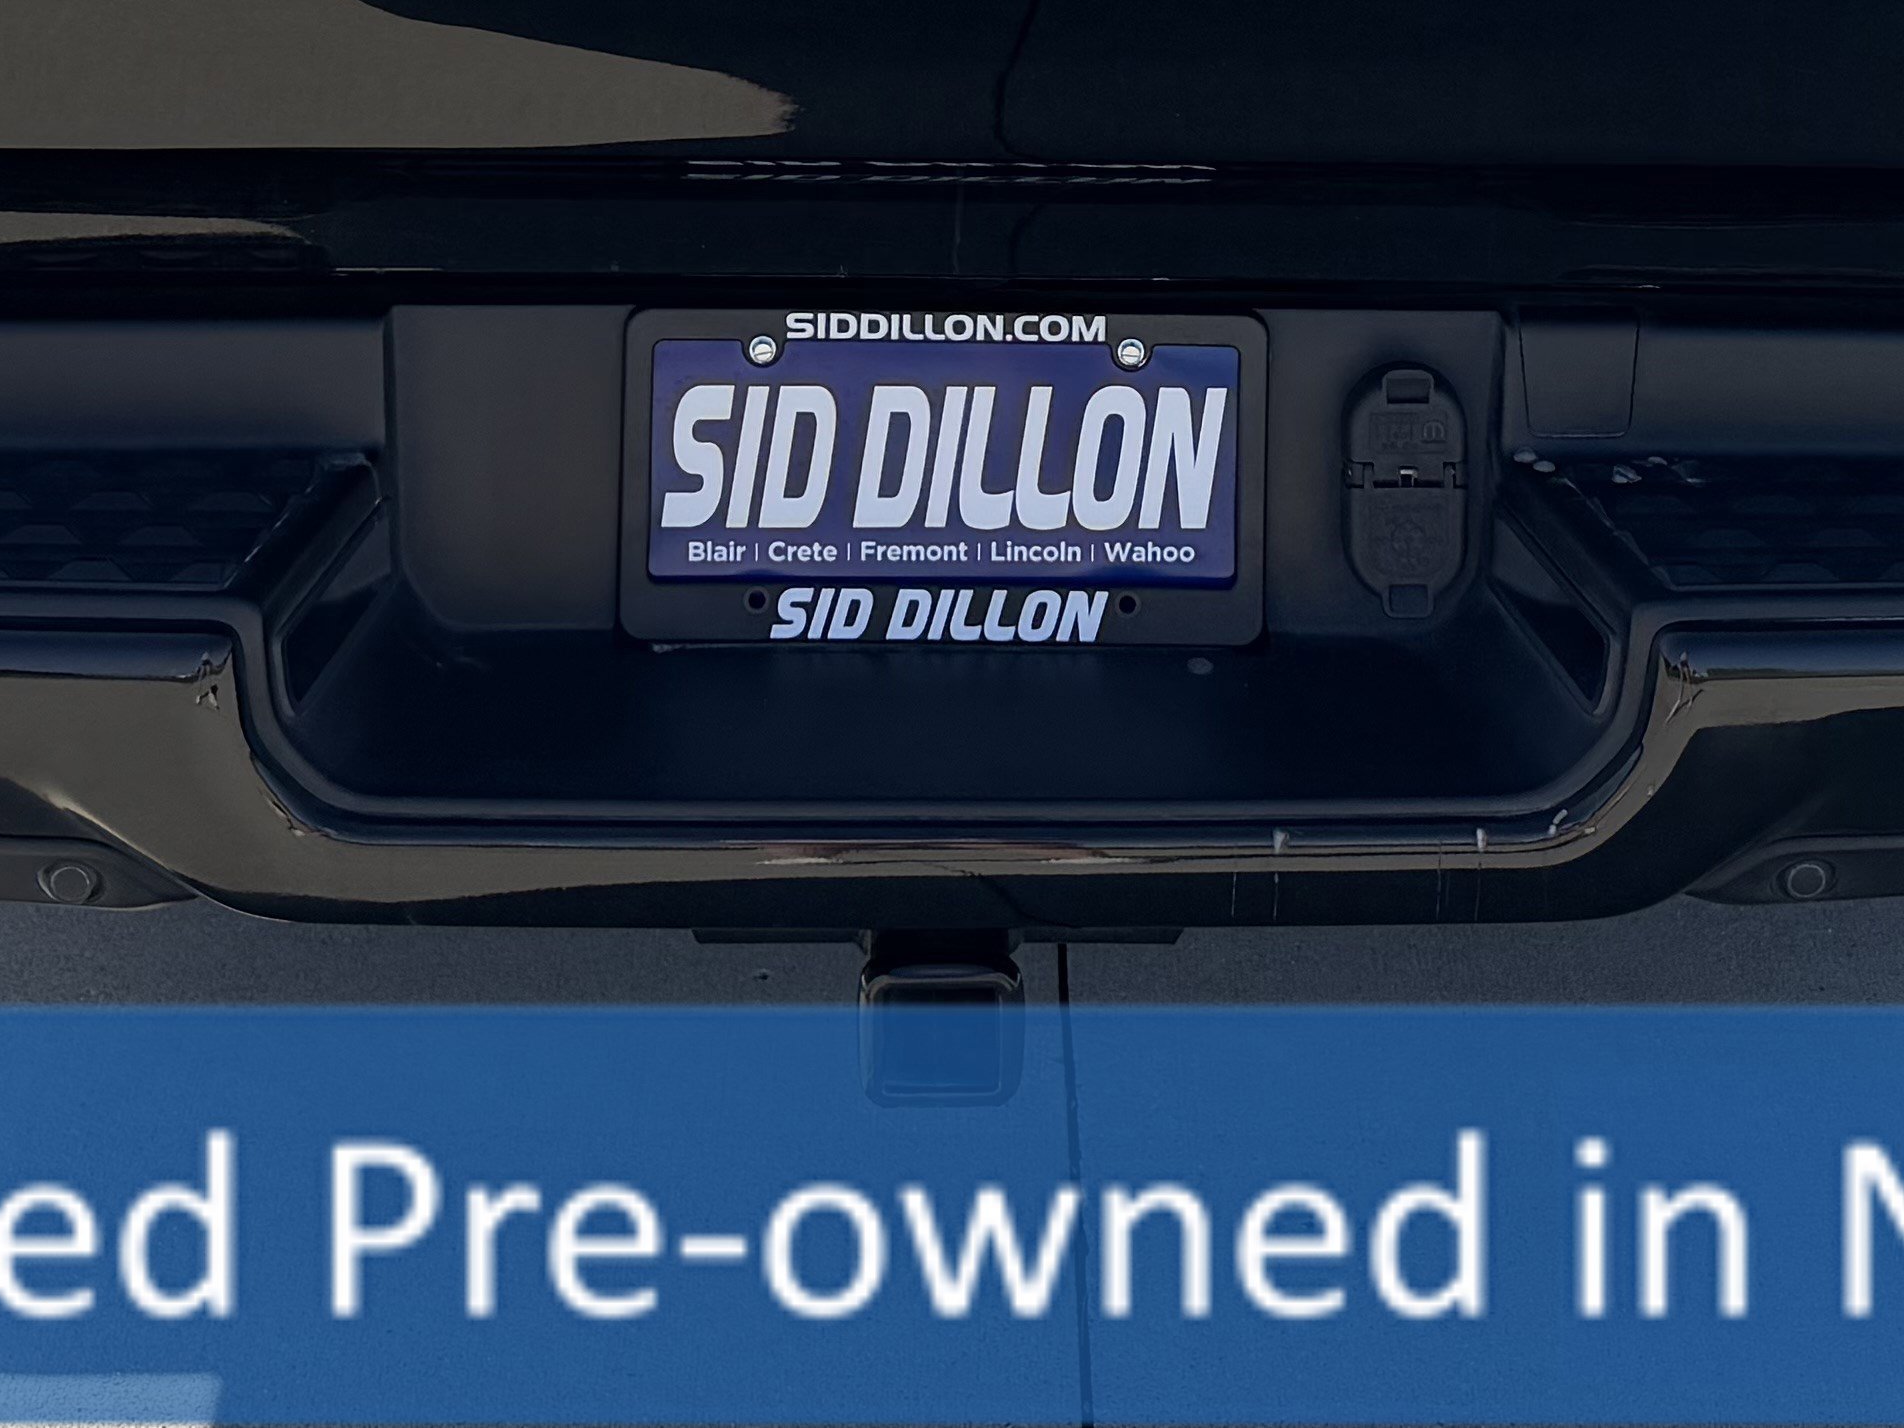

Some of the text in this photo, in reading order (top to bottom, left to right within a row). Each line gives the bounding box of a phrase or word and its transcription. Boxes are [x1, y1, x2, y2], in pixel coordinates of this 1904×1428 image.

[784, 311, 1107, 343] SIDDILLON.COM
[660, 384, 1229, 532] SID DILLON
[687, 539, 1196, 564] Blair Crete Fremont Lincoln Wahoo
[769, 586, 1110, 643] SID DILLON
